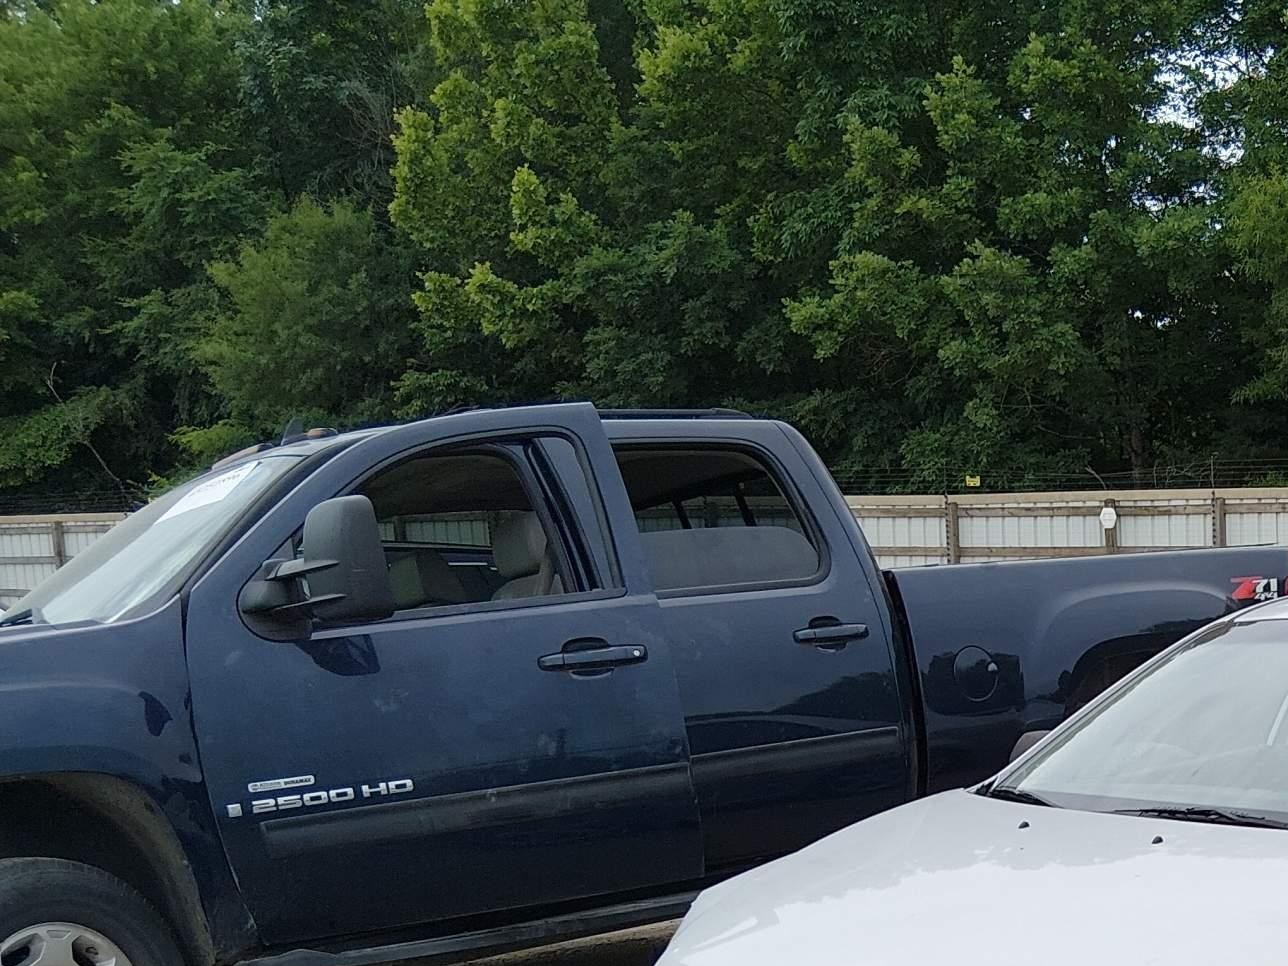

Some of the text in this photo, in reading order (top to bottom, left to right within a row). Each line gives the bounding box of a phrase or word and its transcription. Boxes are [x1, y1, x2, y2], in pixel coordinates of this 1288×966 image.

[1231, 576, 1278, 600] Z71
[252, 779, 414, 814] 2500 HD
